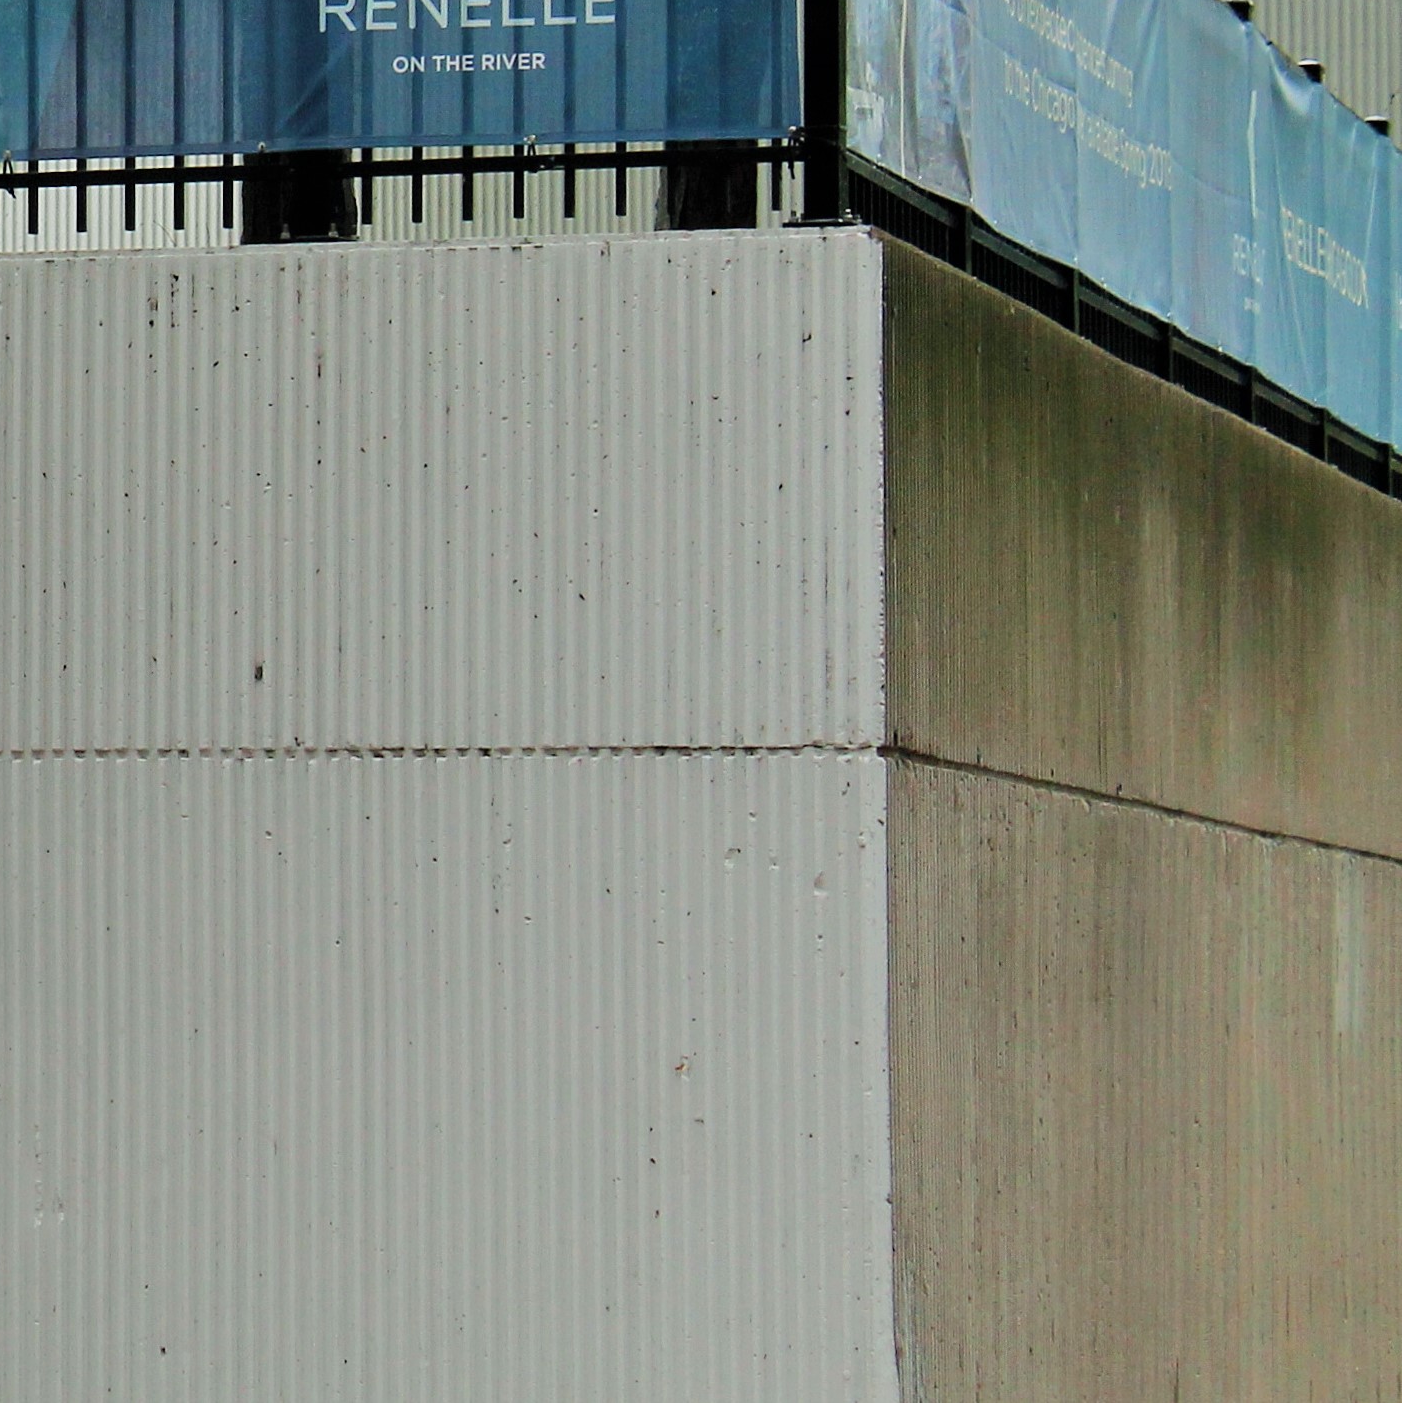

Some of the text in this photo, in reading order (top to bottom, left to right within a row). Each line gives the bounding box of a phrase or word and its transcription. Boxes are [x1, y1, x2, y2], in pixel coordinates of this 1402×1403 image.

[392, 52, 546, 74] ON THE RIVER
